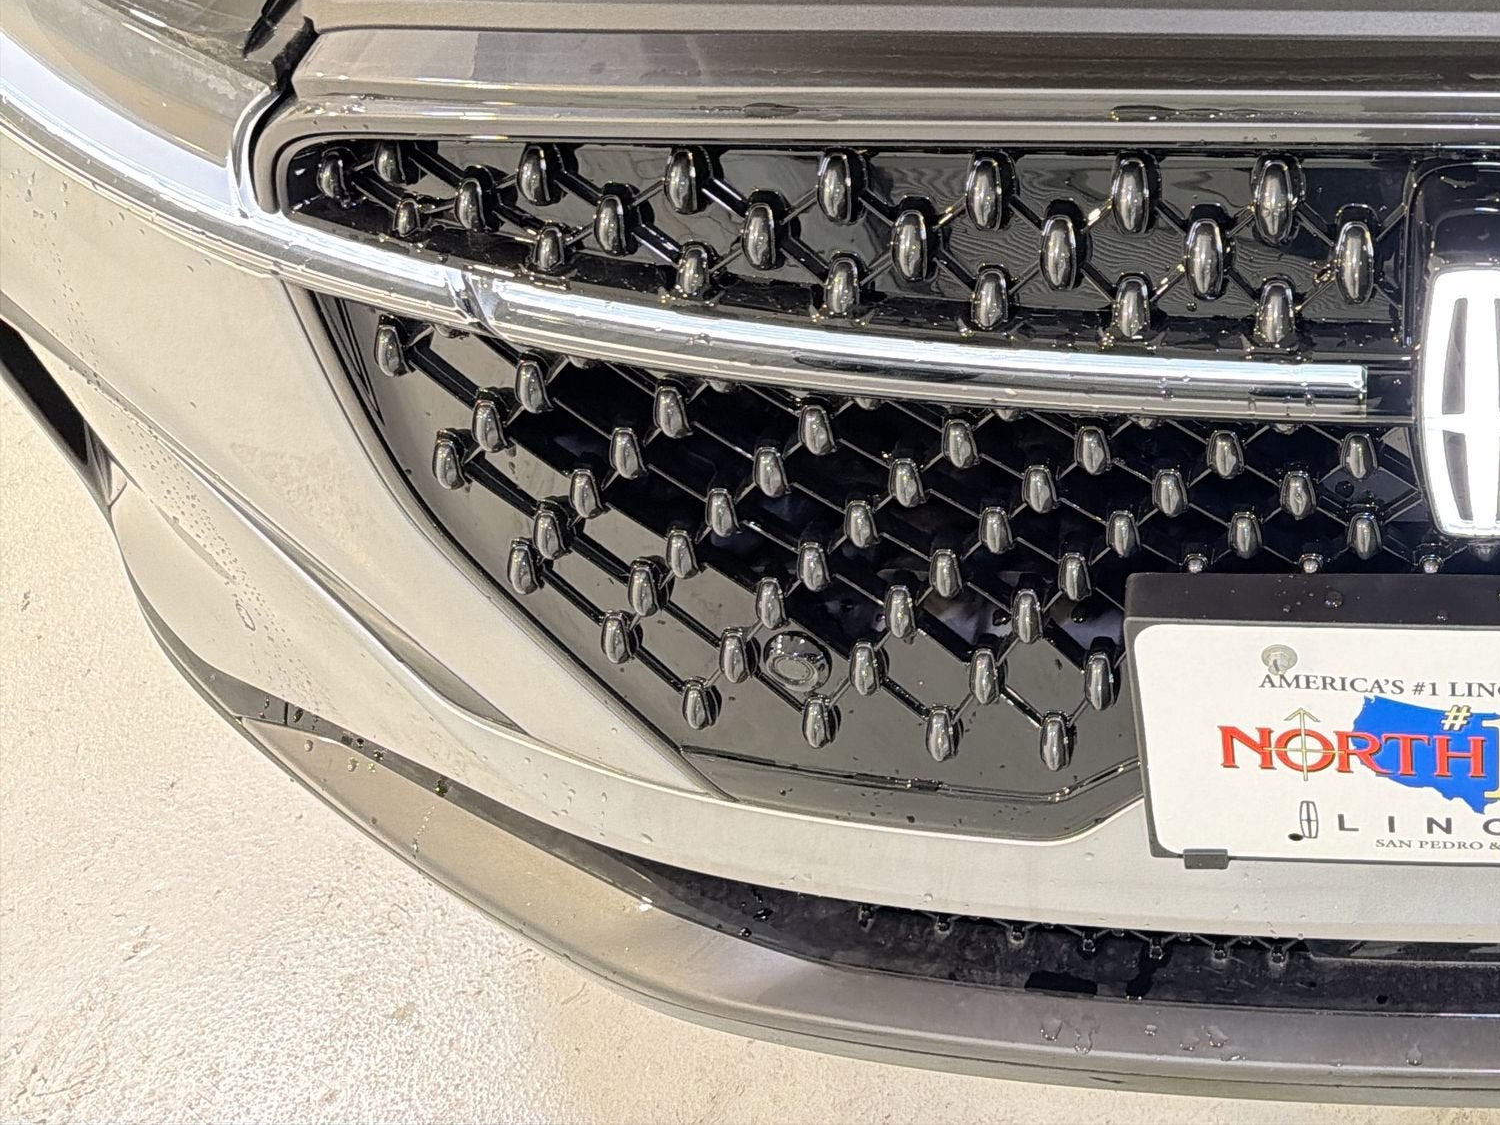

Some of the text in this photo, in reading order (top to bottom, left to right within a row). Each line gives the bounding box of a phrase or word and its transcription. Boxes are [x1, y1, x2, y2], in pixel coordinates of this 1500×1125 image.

[1258, 673, 1404, 695] AMERICA'S
[1412, 681, 1439, 696] #1
[1217, 725, 1487, 778] NORTH
[1375, 839, 1412, 849] SAN
[1419, 840, 1485, 851] PEDRO
